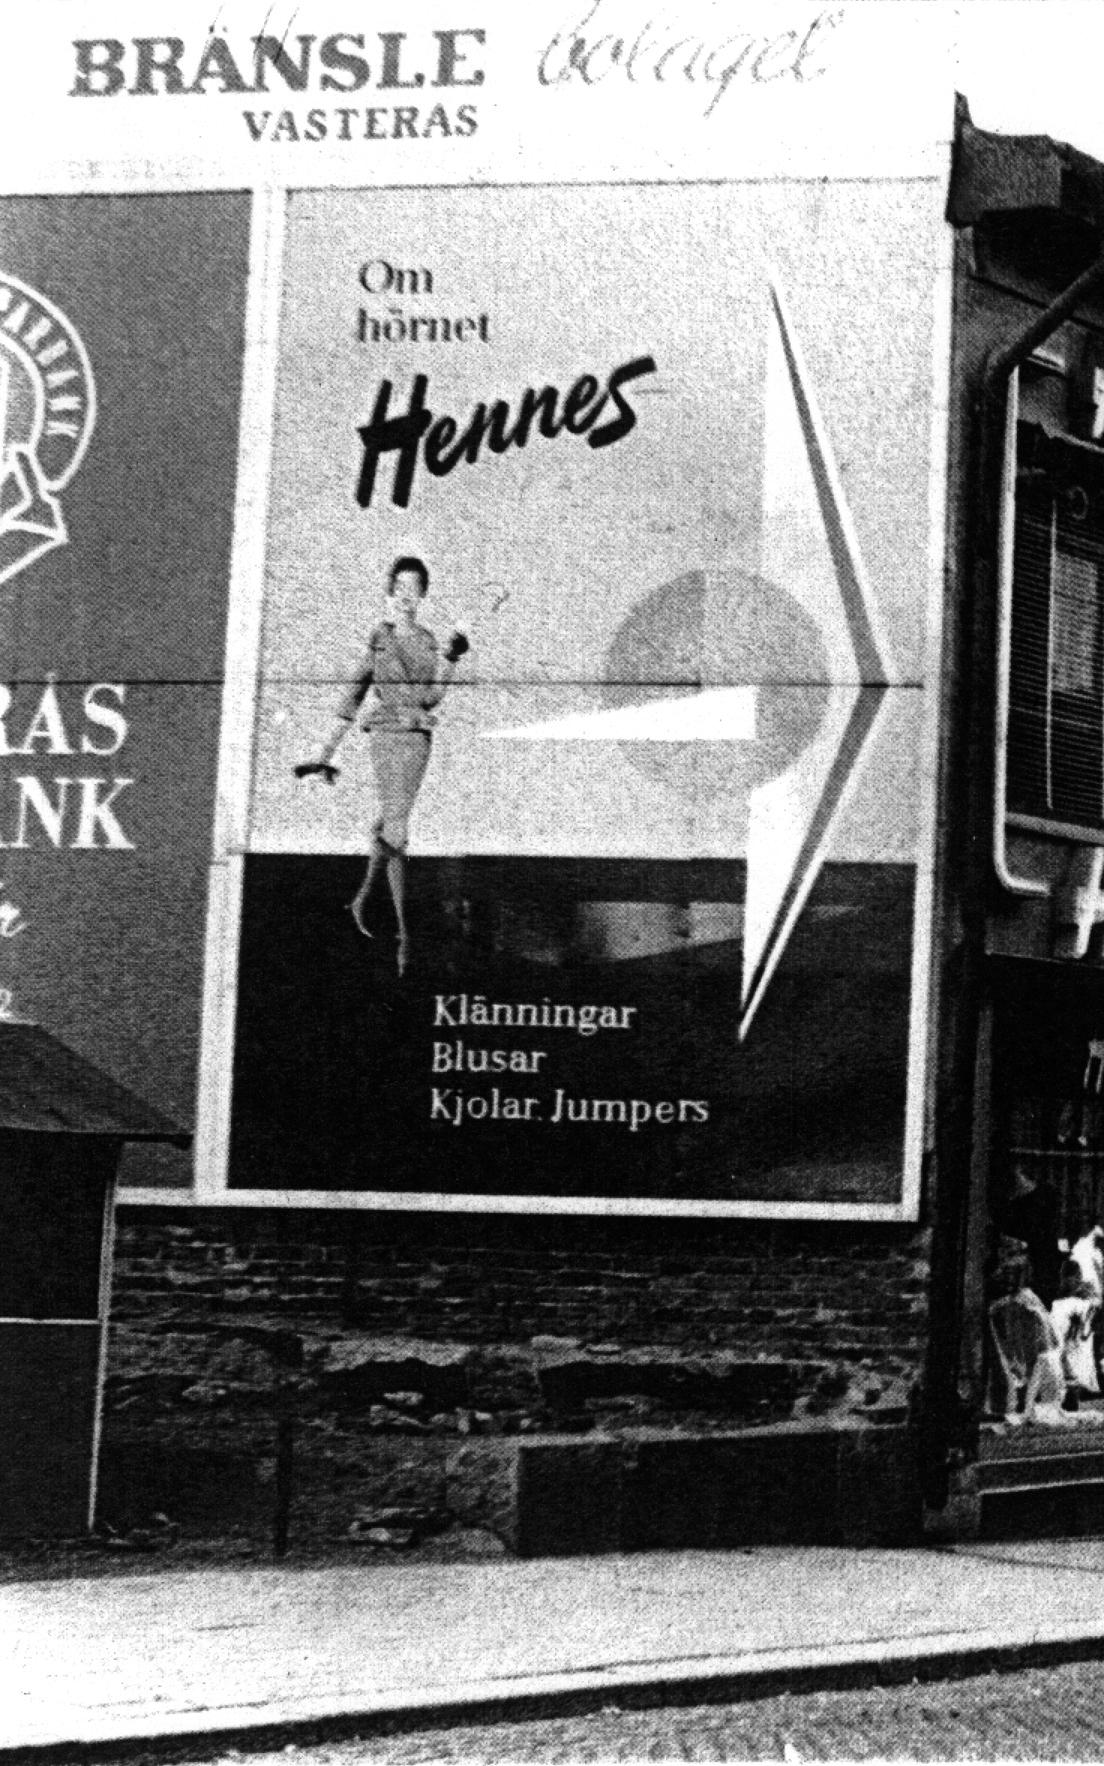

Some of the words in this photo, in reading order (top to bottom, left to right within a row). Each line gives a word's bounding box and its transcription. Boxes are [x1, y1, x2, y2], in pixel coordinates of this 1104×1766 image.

[69, 24, 486, 97] BRÄNSLE
[358, 259, 433, 294] Om
[355, 306, 491, 343] hörnet
[355, 354, 657, 508] Hennes
[0, 672, 128, 755] ÅS
[0, 776, 136, 849] NK
[433, 994, 638, 1036] Klänningar
[432, 1040, 547, 1072] Blusar
[551, 1089, 709, 1132] Jumpers
